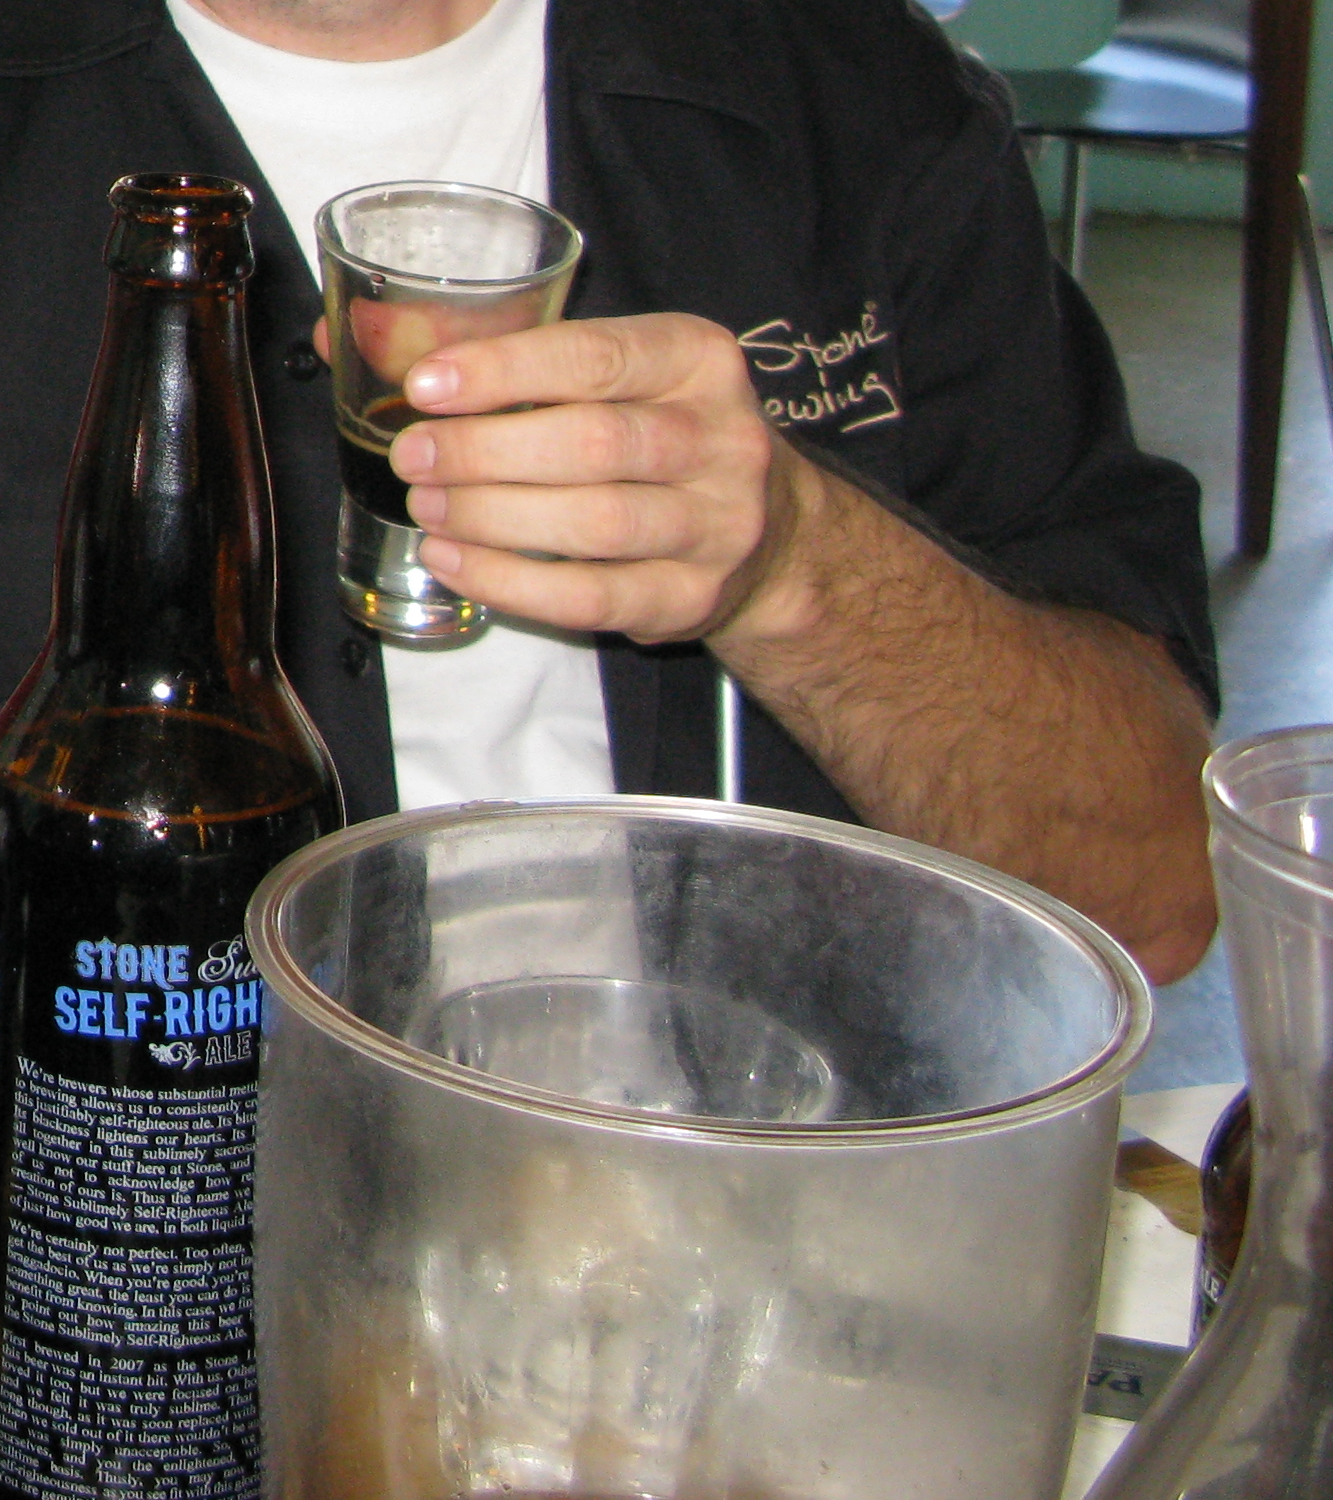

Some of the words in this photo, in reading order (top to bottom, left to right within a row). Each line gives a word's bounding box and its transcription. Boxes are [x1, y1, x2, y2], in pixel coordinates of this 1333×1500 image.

[764, 373, 903, 433] ewing
[75, 936, 190, 990] STONE
[54, 980, 262, 1037] SELF-RIGH
[205, 1030, 252, 1065] ALE
[15, 1077, 26, 1089] to
[30, 1080, 77, 1108] brewing
[81, 1097, 123, 1113] allows
[129, 1104, 143, 1114] us
[149, 1103, 162, 1115] to
[167, 1100, 240, 1115] consistently
[17, 1056, 54, 1083] We're
[58, 1075, 107, 1095] brewers
[112, 1083, 154, 1100] whose
[157, 1087, 226, 1100] substantial
[14, 1091, 33, 1107] this
[34, 1099, 94, 1125] justifiably
[99, 1114, 189, 1131] self-righteous
[192, 1119, 213, 1129] ale.
[218, 1115, 232, 1127] Its
[14, 1105, 27, 1119] Its
[33, 1112, 90, 1137] blackness
[96, 1124, 148, 1144] lightens
[155, 1132, 178, 1144] our
[185, 1130, 226, 1143] hearts.
[232, 1129, 246, 1140] Its
[14, 1121, 26, 1134] all
[33, 1128, 82, 1151] together
[89, 1142, 103, 1155] in
[110, 1145, 134, 1157] this
[143, 1146, 207, 1163] sublimely
[26, 1184, 59, 1204] Stone
[63, 1193, 129, 1219] Sublimely
[134, 1205, 229, 1220] Self-Righteous
[45, 1232, 98, 1256] certainly
[103, 1246, 124, 1259] not
[128, 1249, 178, 1260] perfect.
[183, 1248, 209, 1259] Too
[213, 1243, 246, 1256] often,
[67, 1283, 104, 1300] great,
[109, 1290, 129, 1301] the
[134, 1290, 164, 1302] least
[169, 1292, 193, 1306] you
[197, 1291, 218, 1300] can
[223, 1285, 238, 1296] do
[242, 1283, 251, 1293] is
[34, 1342, 79, 1363] brewed
[88, 1354, 101, 1367] in
[111, 1360, 144, 1371] 2007
[154, 1362, 167, 1372] as
